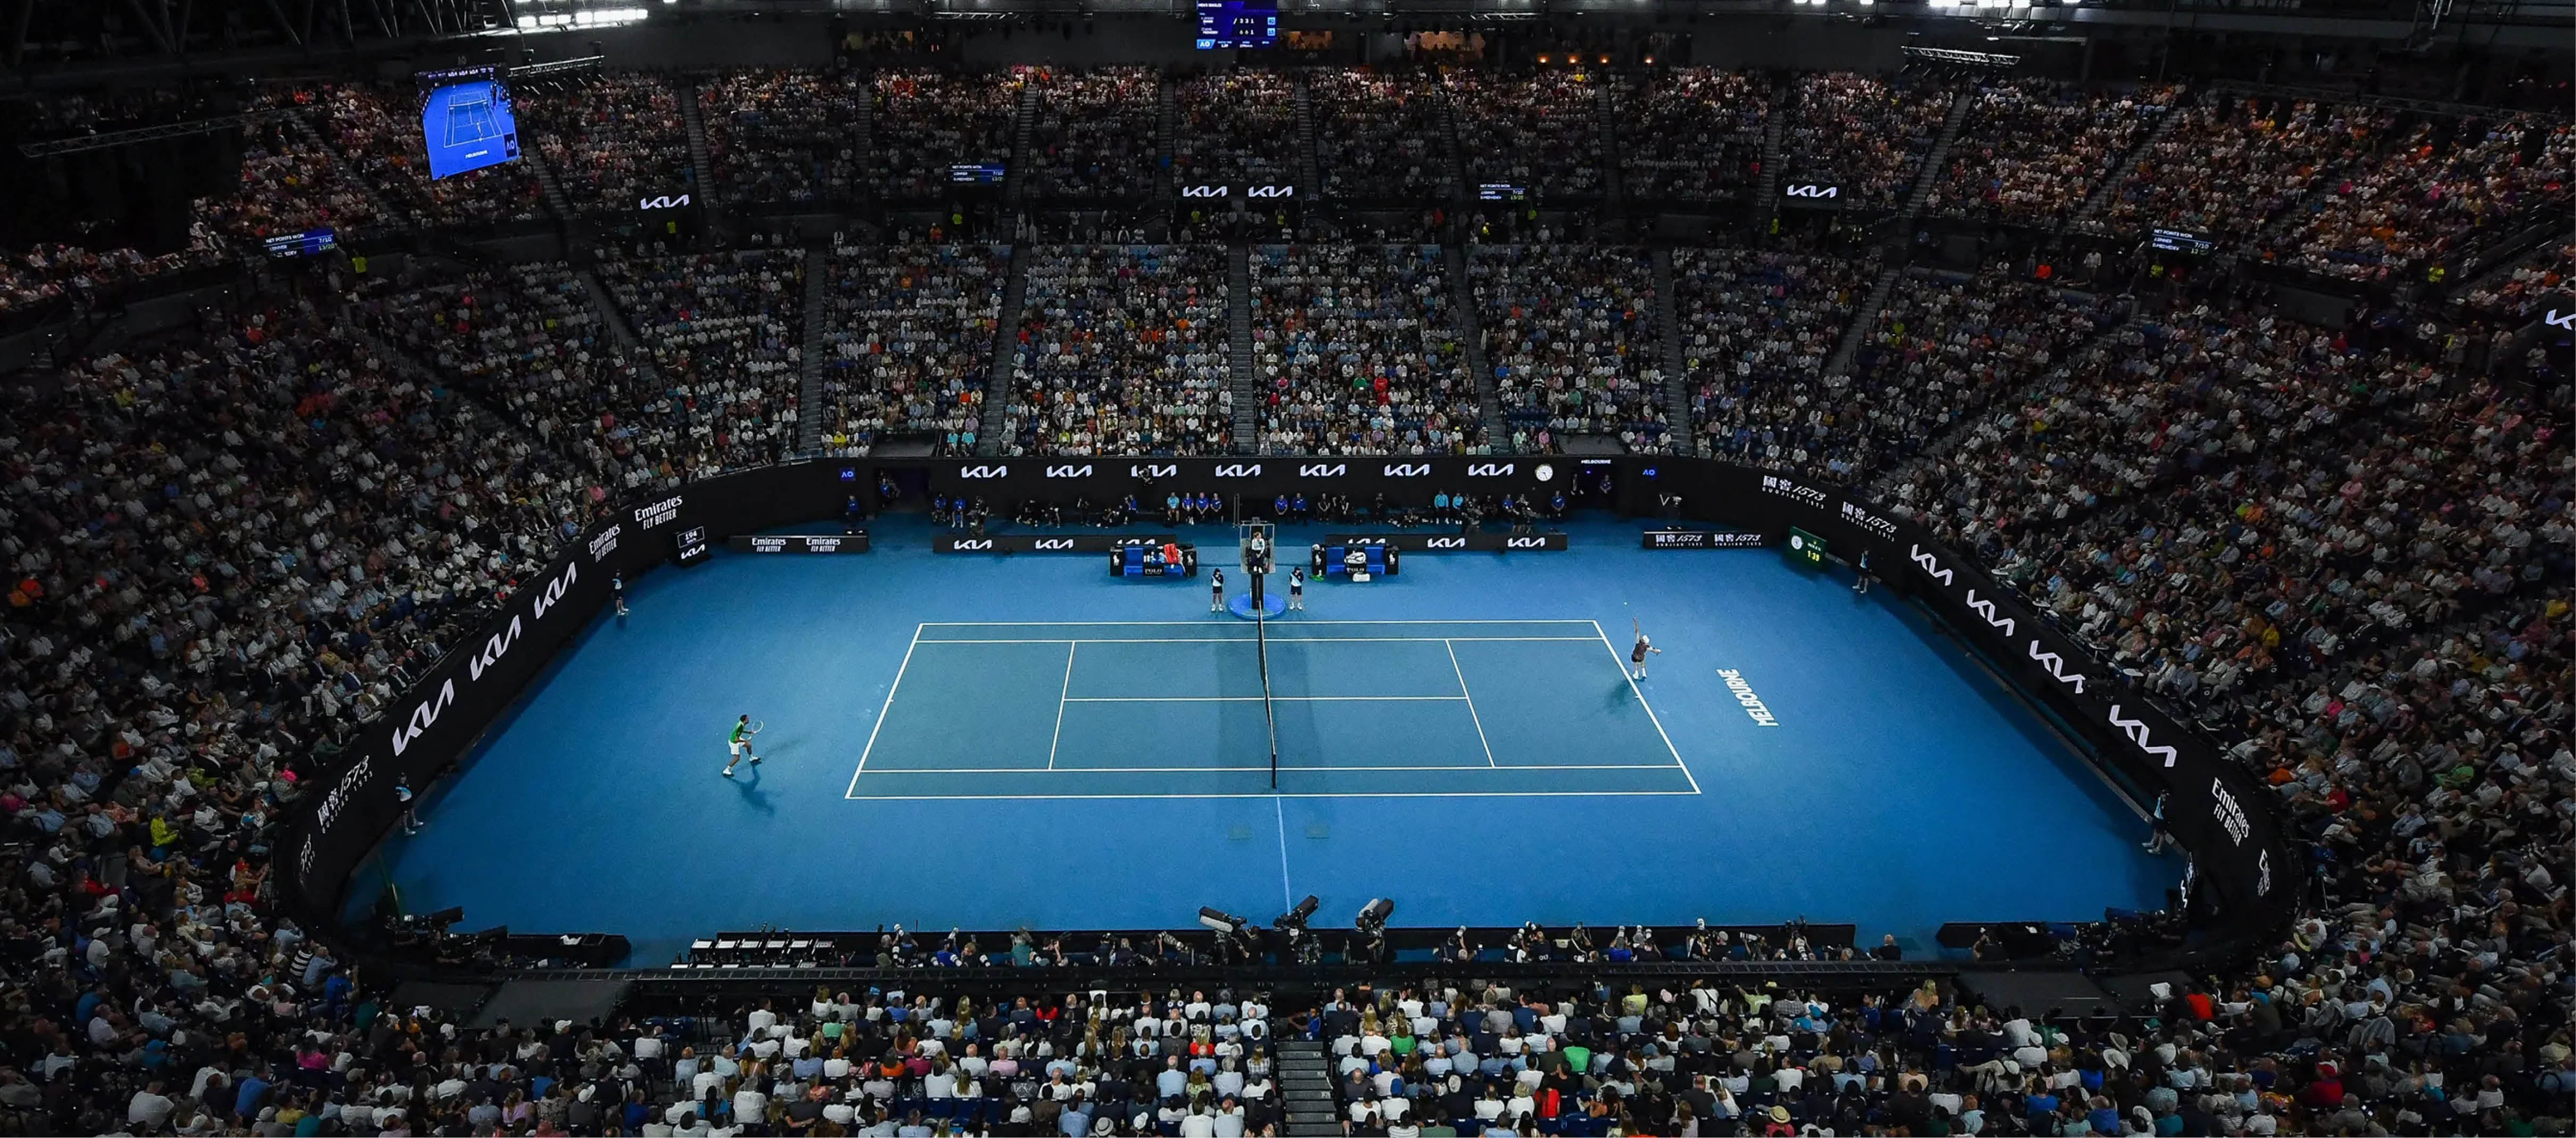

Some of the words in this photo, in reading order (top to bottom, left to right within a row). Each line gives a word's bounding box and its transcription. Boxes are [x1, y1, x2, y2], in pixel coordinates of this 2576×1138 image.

[1183, 186, 1227, 197] KIA
[1249, 186, 1293, 197] KIA
[1787, 184, 1837, 198] KIA
[640, 194, 689, 209] KIA
[961, 466, 1007, 478] KIA
[1046, 465, 1092, 477] KIA
[1215, 464, 1261, 477] KIA
[1300, 464, 1345, 476] KIA
[1384, 464, 1430, 476] KIA
[1468, 464, 1514, 476] KIA
[634, 495, 683, 522] Emirates
[643, 517, 654, 530] FLY
[654, 508, 678, 526] BETTER
[589, 523, 621, 555] Emirates
[685, 530, 697, 540] 194
[1508, 537, 1545, 547] KIA
[954, 539, 992, 549] KIA
[1035, 539, 1074, 549] KIA
[1427, 538, 1465, 548] KIA
[681, 543, 706, 559] KIA
[1911, 544, 1953, 586] KIA
[534, 561, 577, 620] KIA
[1967, 589, 2014, 637] KIA
[470, 614, 521, 681] KIA
[2029, 640, 2085, 694] KIA
[1716, 669, 1780, 726] MELBOURNE
[392, 678, 455, 756] KIA
[2109, 705, 2177, 768] KIA
[2211, 777, 2251, 838] Emirates
[2214, 803, 2226, 822] FLY
[2224, 815, 2242, 847] BETTER
